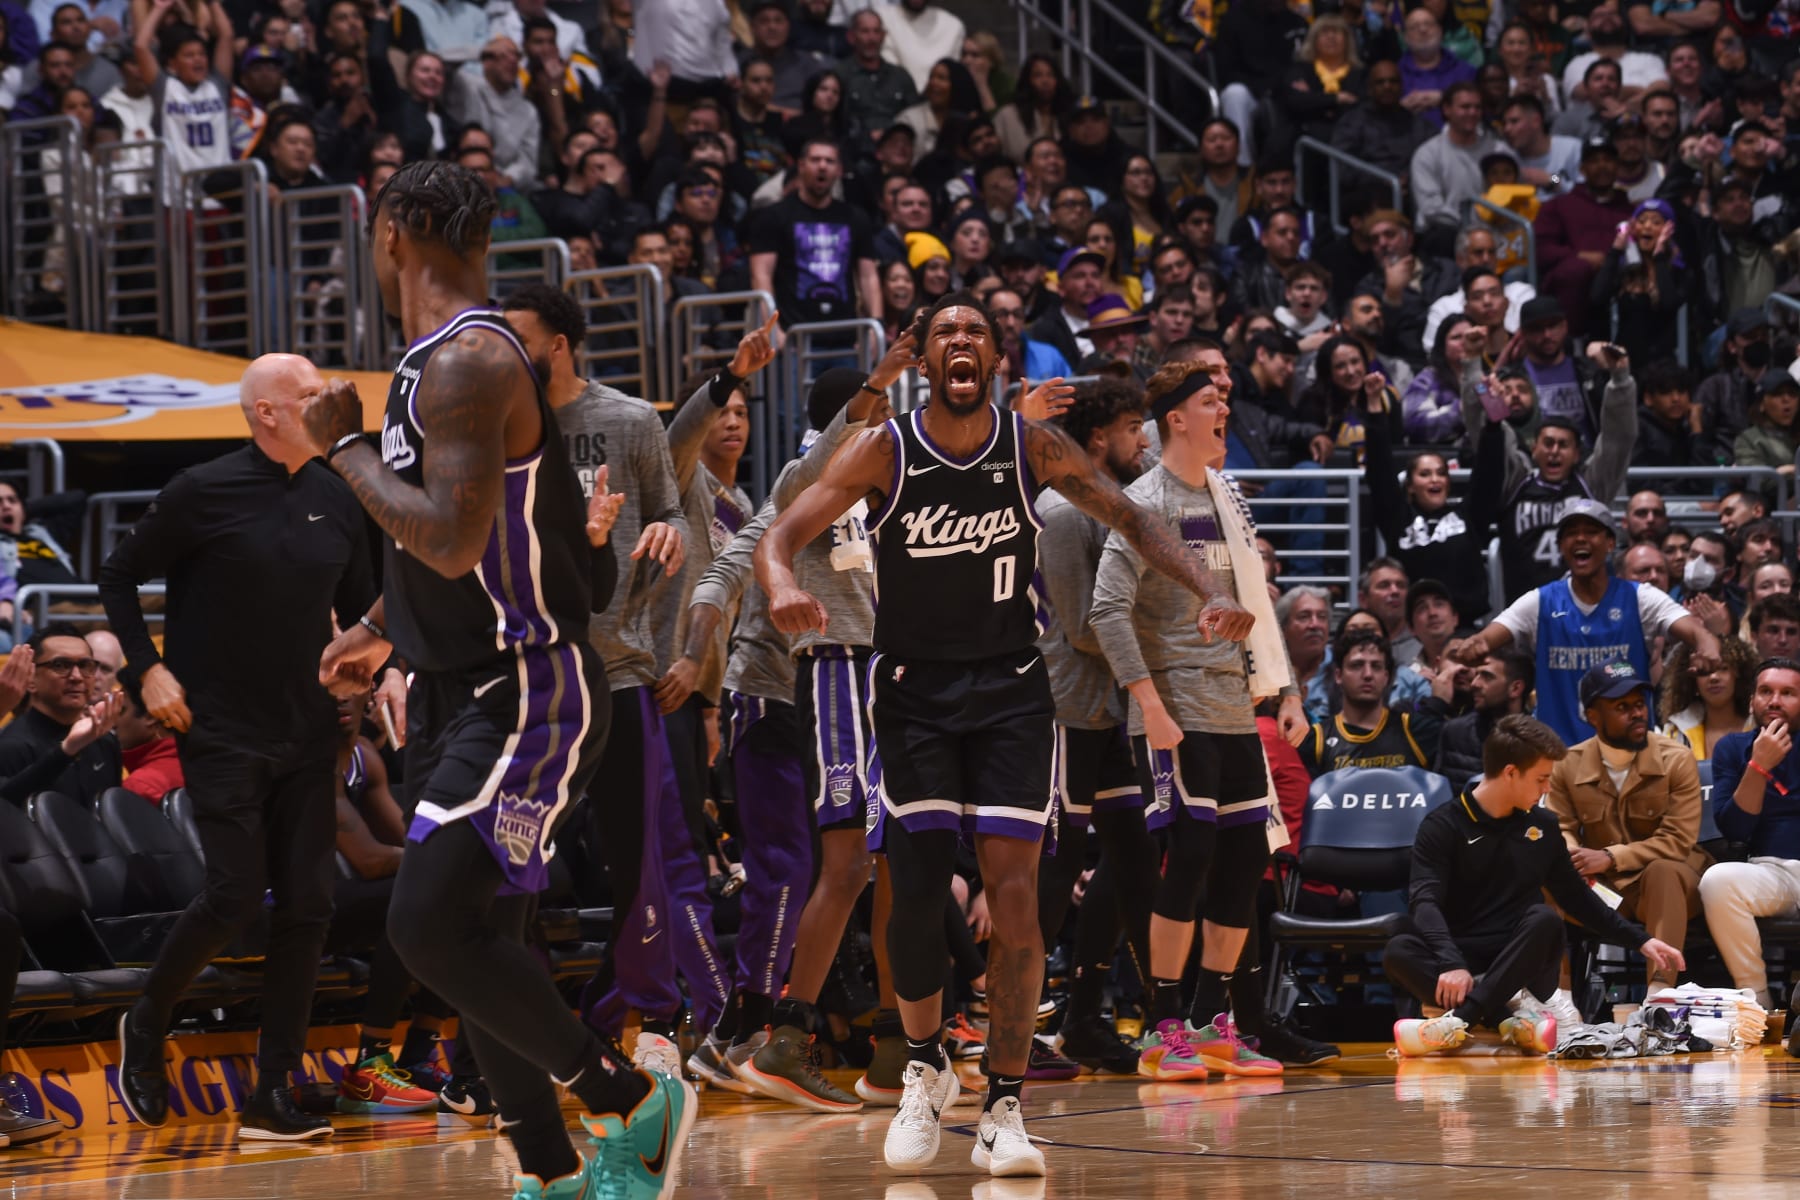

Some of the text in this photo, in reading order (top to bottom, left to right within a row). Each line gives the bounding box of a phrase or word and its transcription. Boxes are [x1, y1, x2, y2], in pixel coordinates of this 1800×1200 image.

[186, 121, 214, 148] 10
[981, 461, 1014, 471] dialpad
[900, 504, 1020, 557] Kings
[1515, 502, 1564, 537] KING
[993, 555, 1016, 602] 0
[1548, 645, 1630, 670] KENTUCKY
[1341, 793, 1427, 809] DELTA
